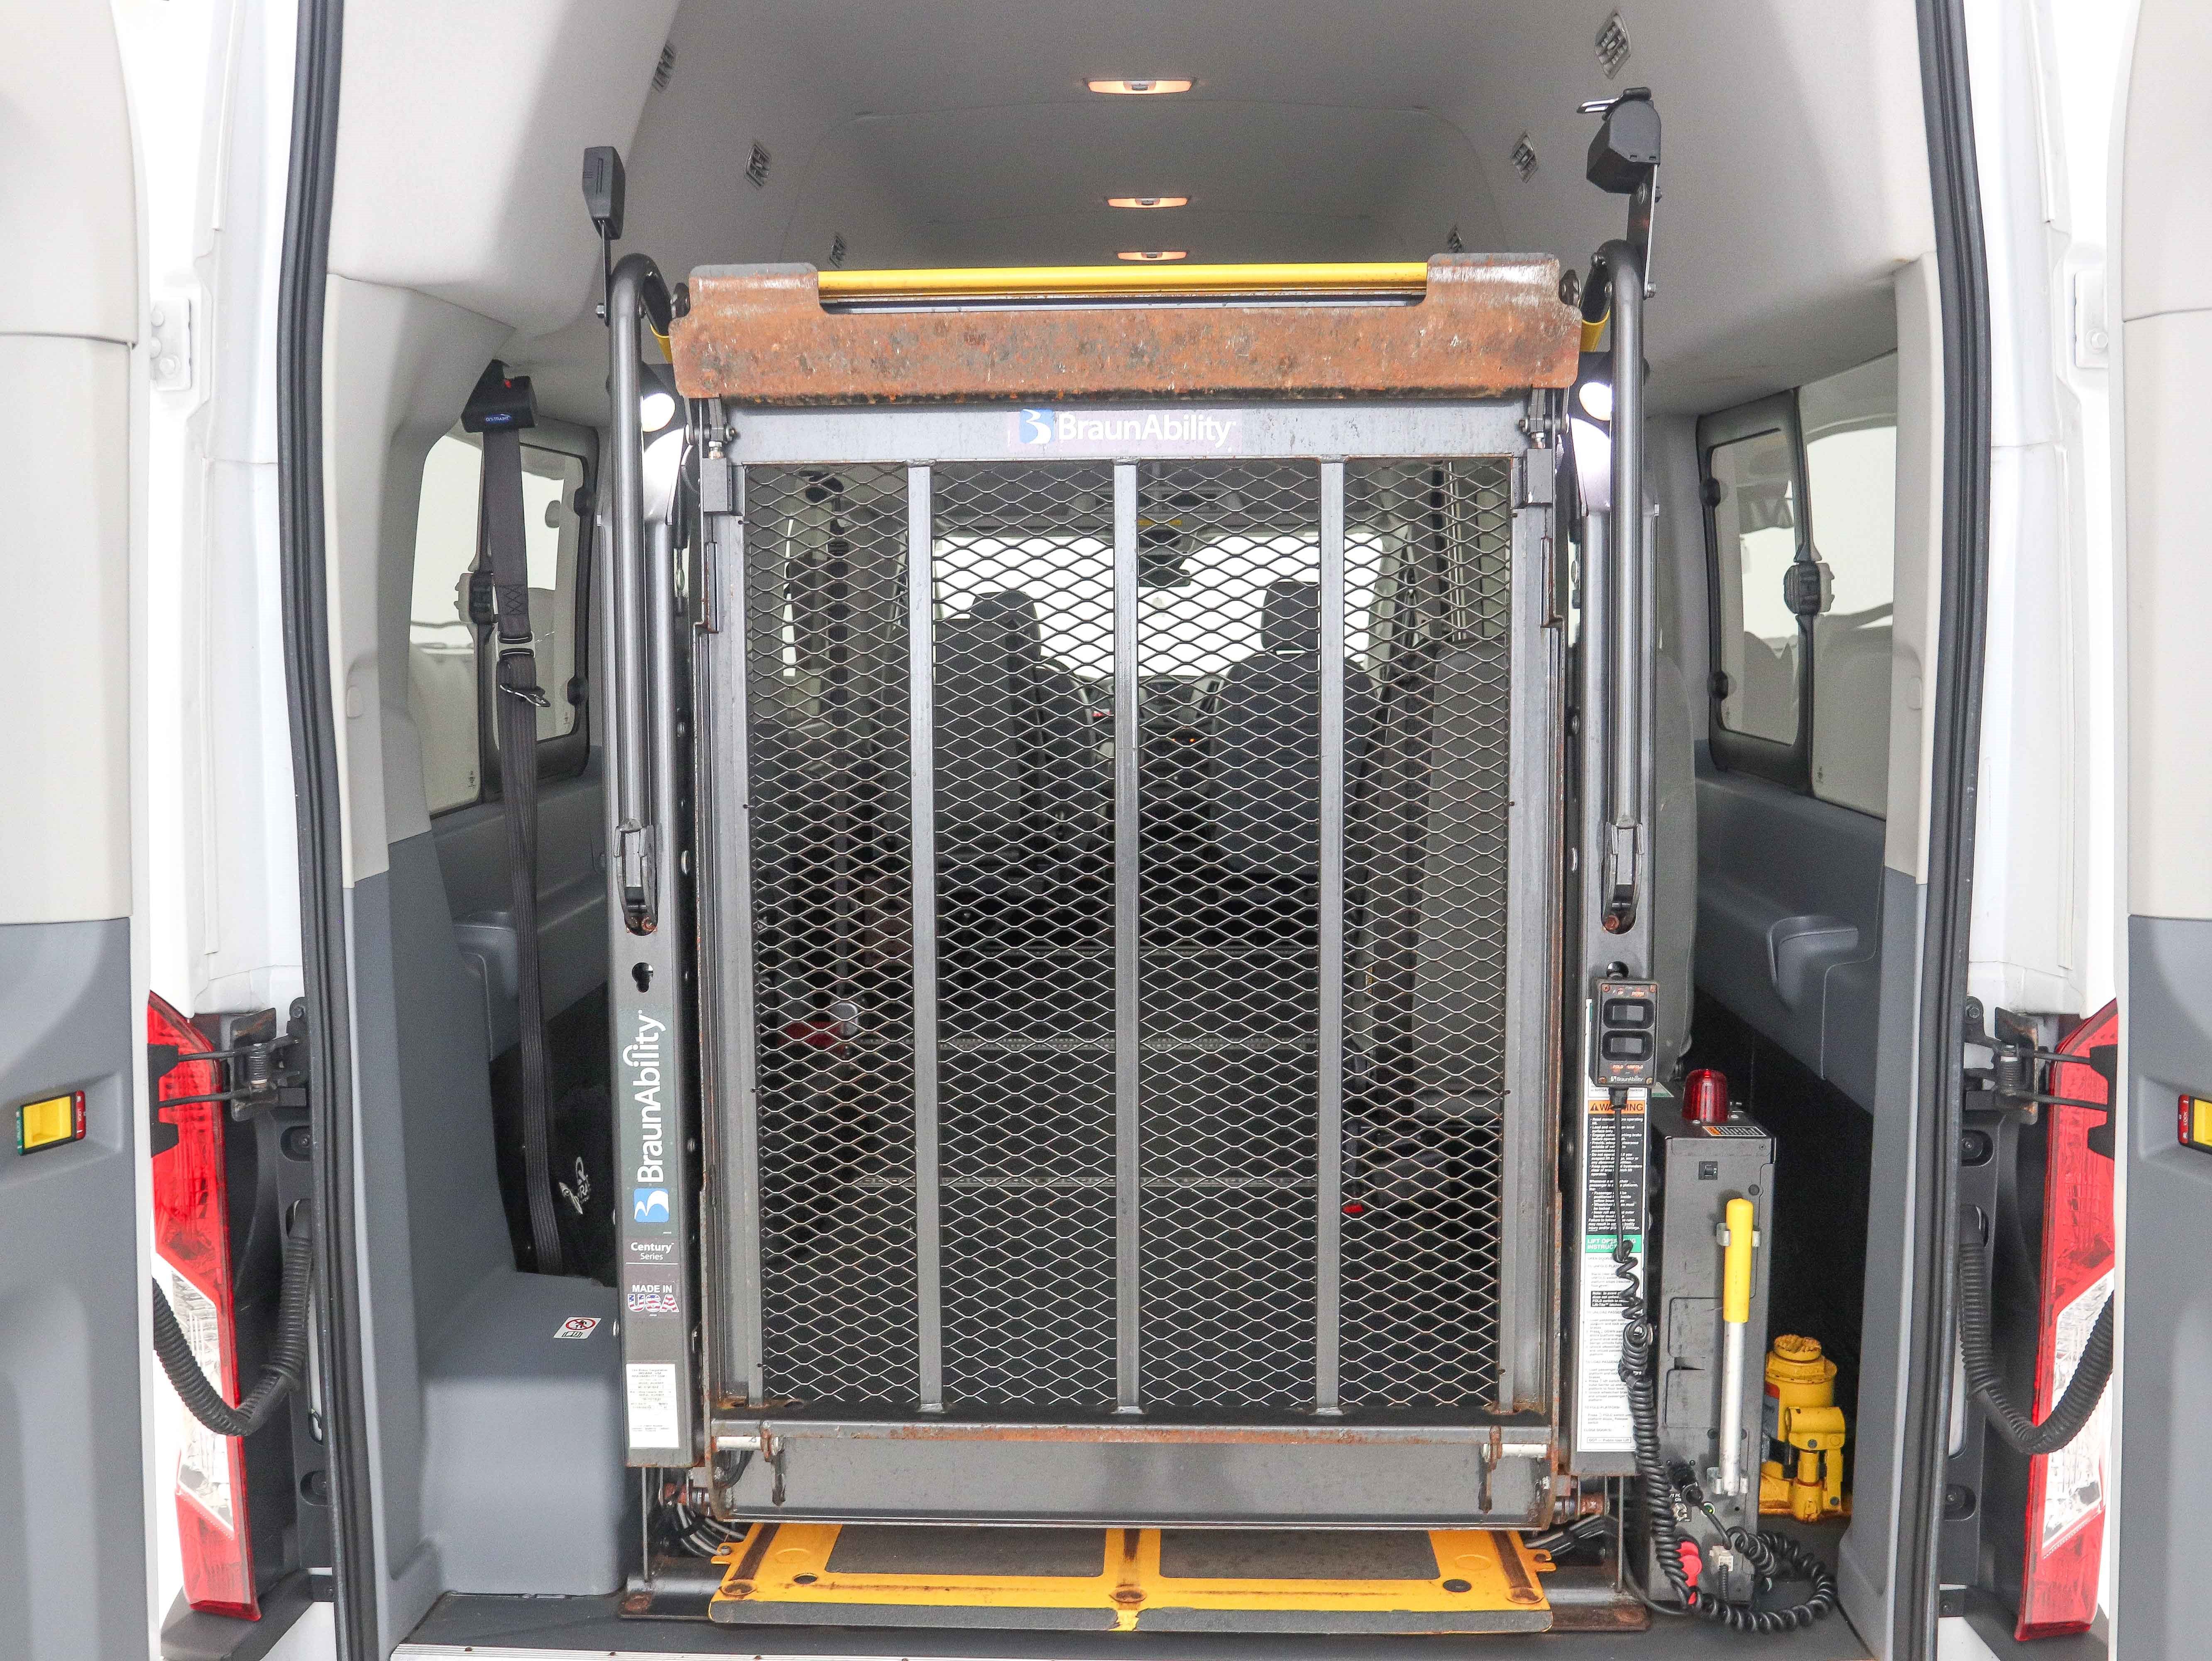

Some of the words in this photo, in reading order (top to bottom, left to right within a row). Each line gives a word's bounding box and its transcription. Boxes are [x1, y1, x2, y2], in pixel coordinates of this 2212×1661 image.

[1058, 413, 1232, 448] BraunAbility
[623, 1013, 666, 1183] BraunAbility
[631, 1242, 673, 1254] Century
[632, 1284, 661, 1293] MADE
[663, 1285, 673, 1293] IN
[627, 1294, 680, 1313] USA
